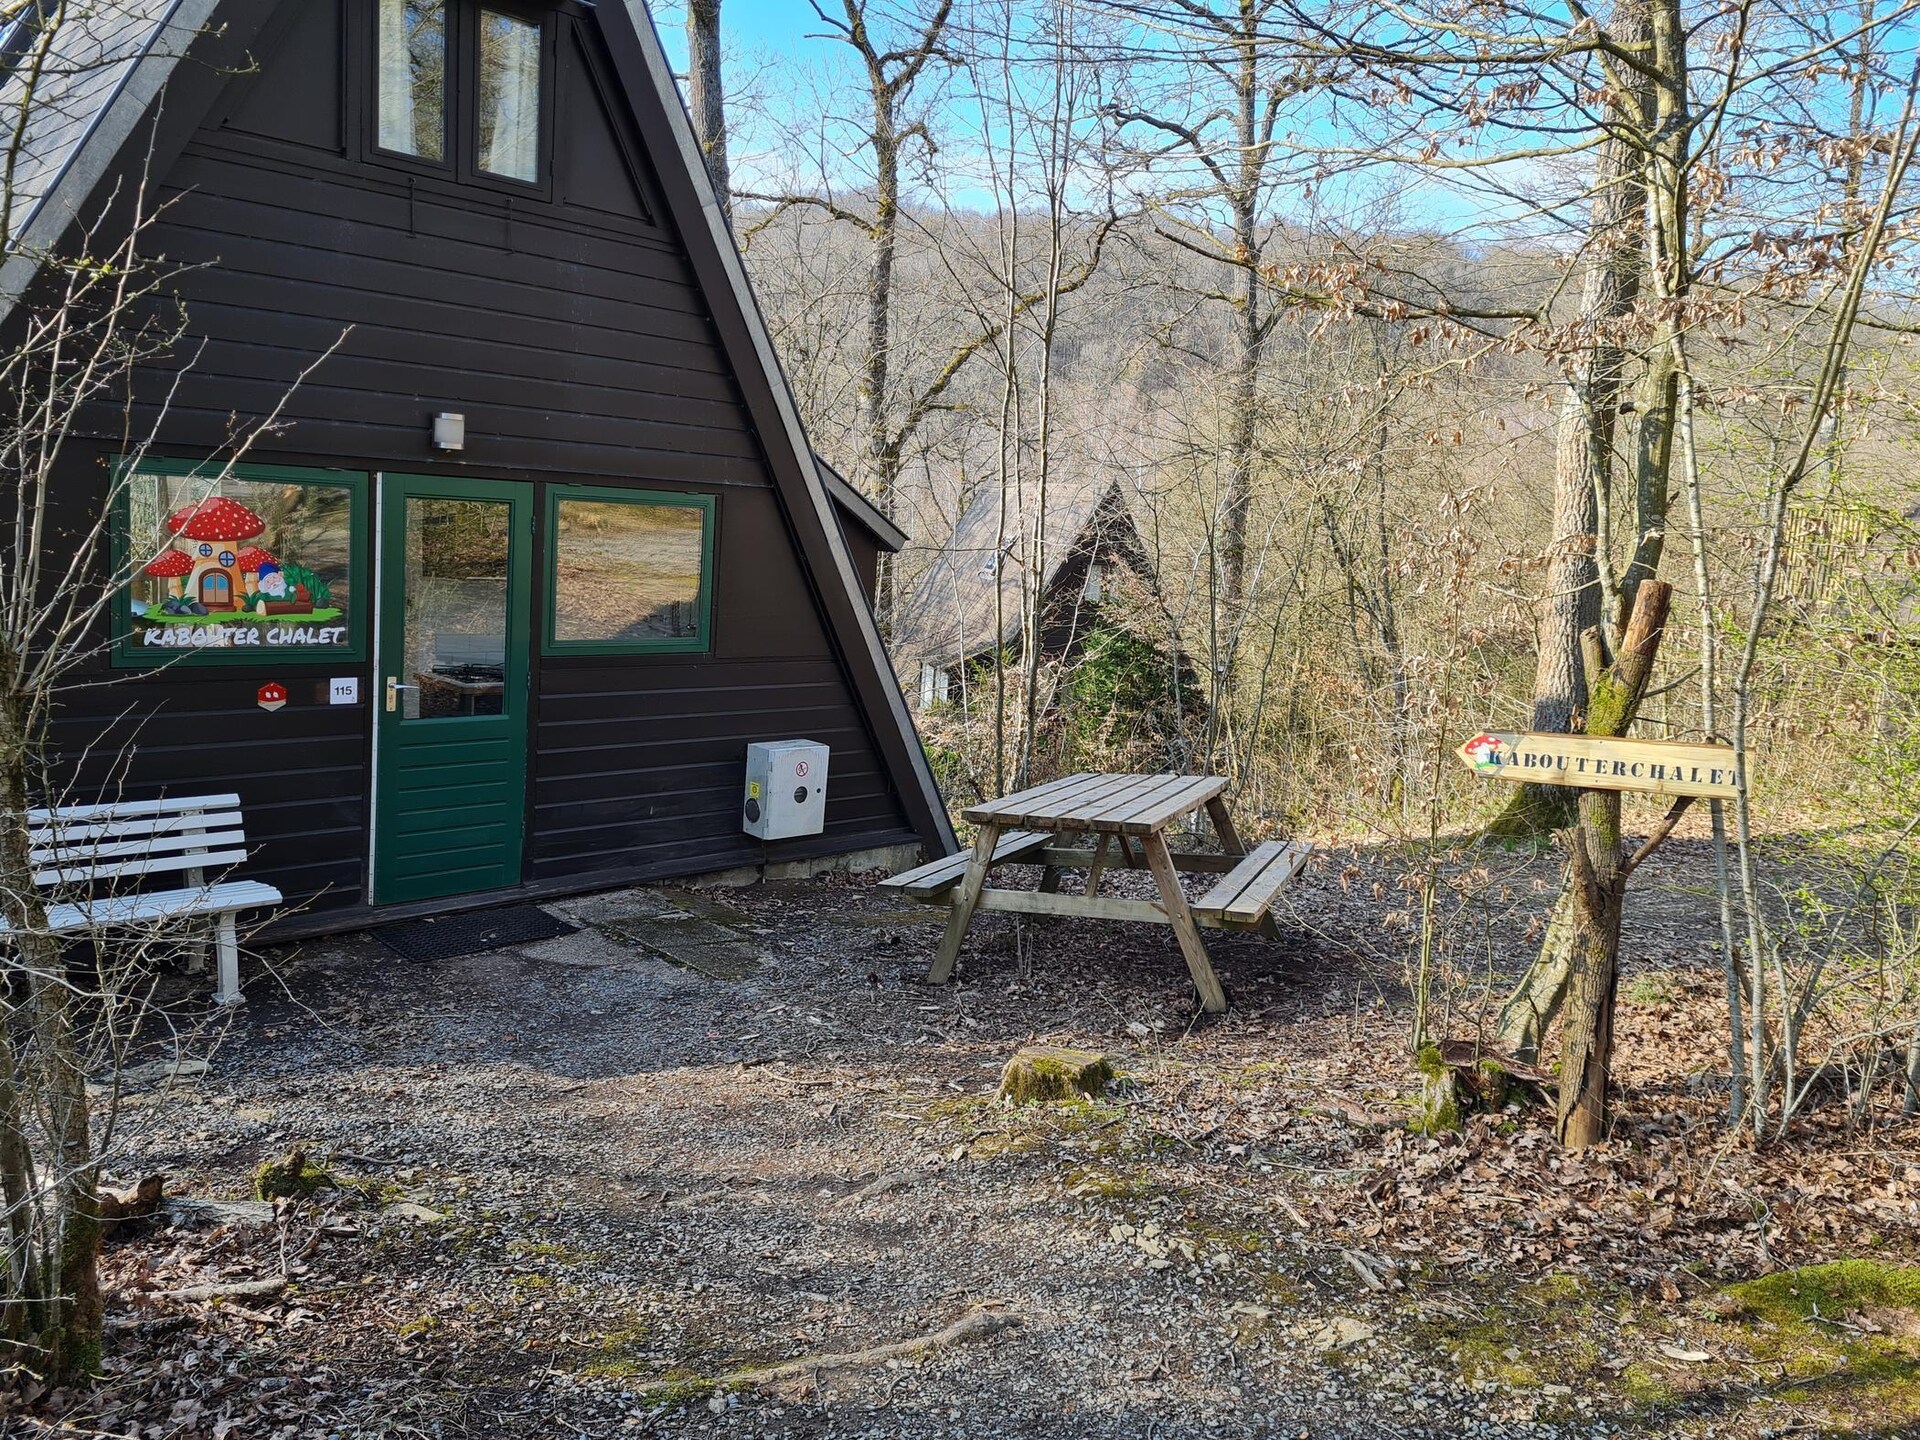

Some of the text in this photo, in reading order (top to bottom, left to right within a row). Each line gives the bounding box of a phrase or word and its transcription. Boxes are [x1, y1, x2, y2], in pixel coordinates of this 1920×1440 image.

[144, 627, 345, 646] KABOUTER CHALET
[334, 686, 352, 696] 115
